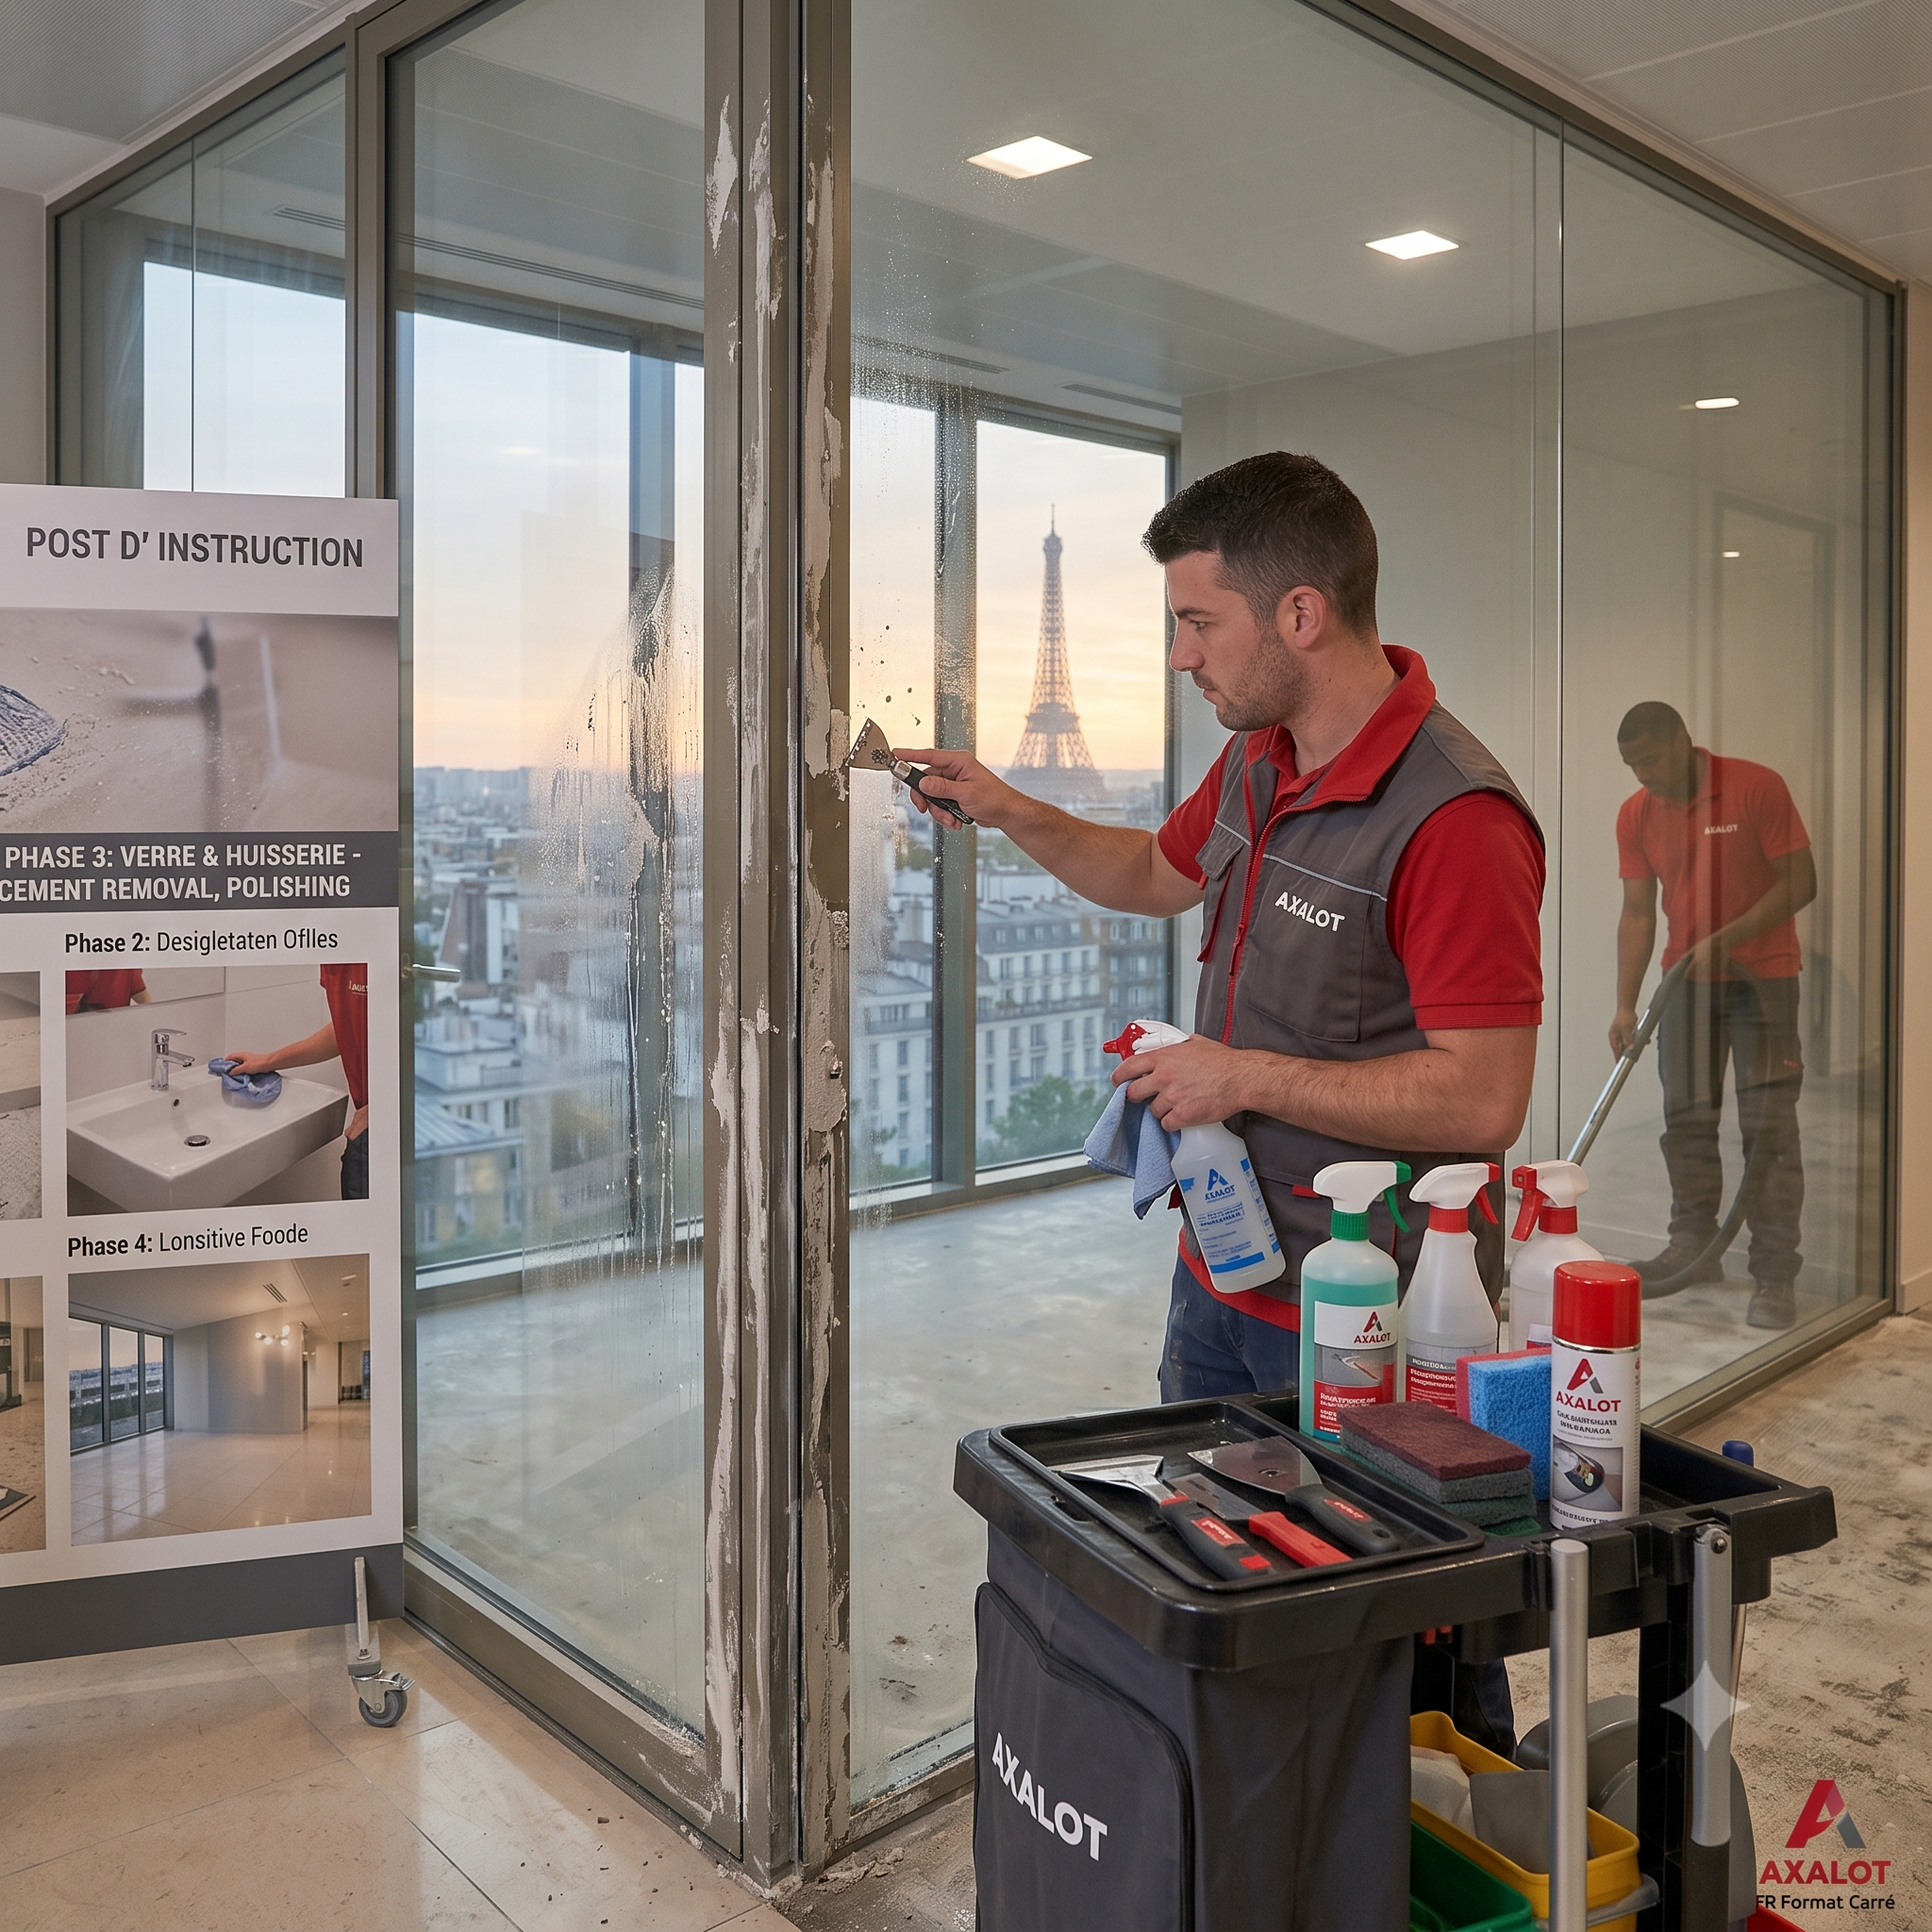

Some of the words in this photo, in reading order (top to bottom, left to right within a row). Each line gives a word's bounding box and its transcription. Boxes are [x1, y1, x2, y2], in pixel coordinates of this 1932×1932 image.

[26, 526, 111, 560] POST
[158, 531, 364, 568] INSTRUCTION
[5, 845, 86, 869] PHASE
[92, 845, 113, 868] 3:
[120, 844, 196, 867] VERRE
[202, 844, 219, 867] &
[225, 843, 346, 867] HUISSERIE
[0, 877, 96, 902] CEMENT
[102, 876, 220, 903] REMOVAL,
[226, 874, 351, 898] POLISHING
[1274, 891, 1345, 932] AXALOT
[65, 933, 126, 954] Phase
[131, 932, 150, 952] 2:
[157, 929, 277, 956] Desigletaten
[68, 1236, 129, 1257] Phase
[134, 1233, 153, 1253] 4:
[159, 1227, 245, 1252] Lonsitive
[251, 1223, 308, 1247] Foode
[1354, 1332, 1391, 1343] AXALOT
[1556, 1391, 1622, 1413] AXALOT
[991, 1731, 1108, 1861] AXALOT
